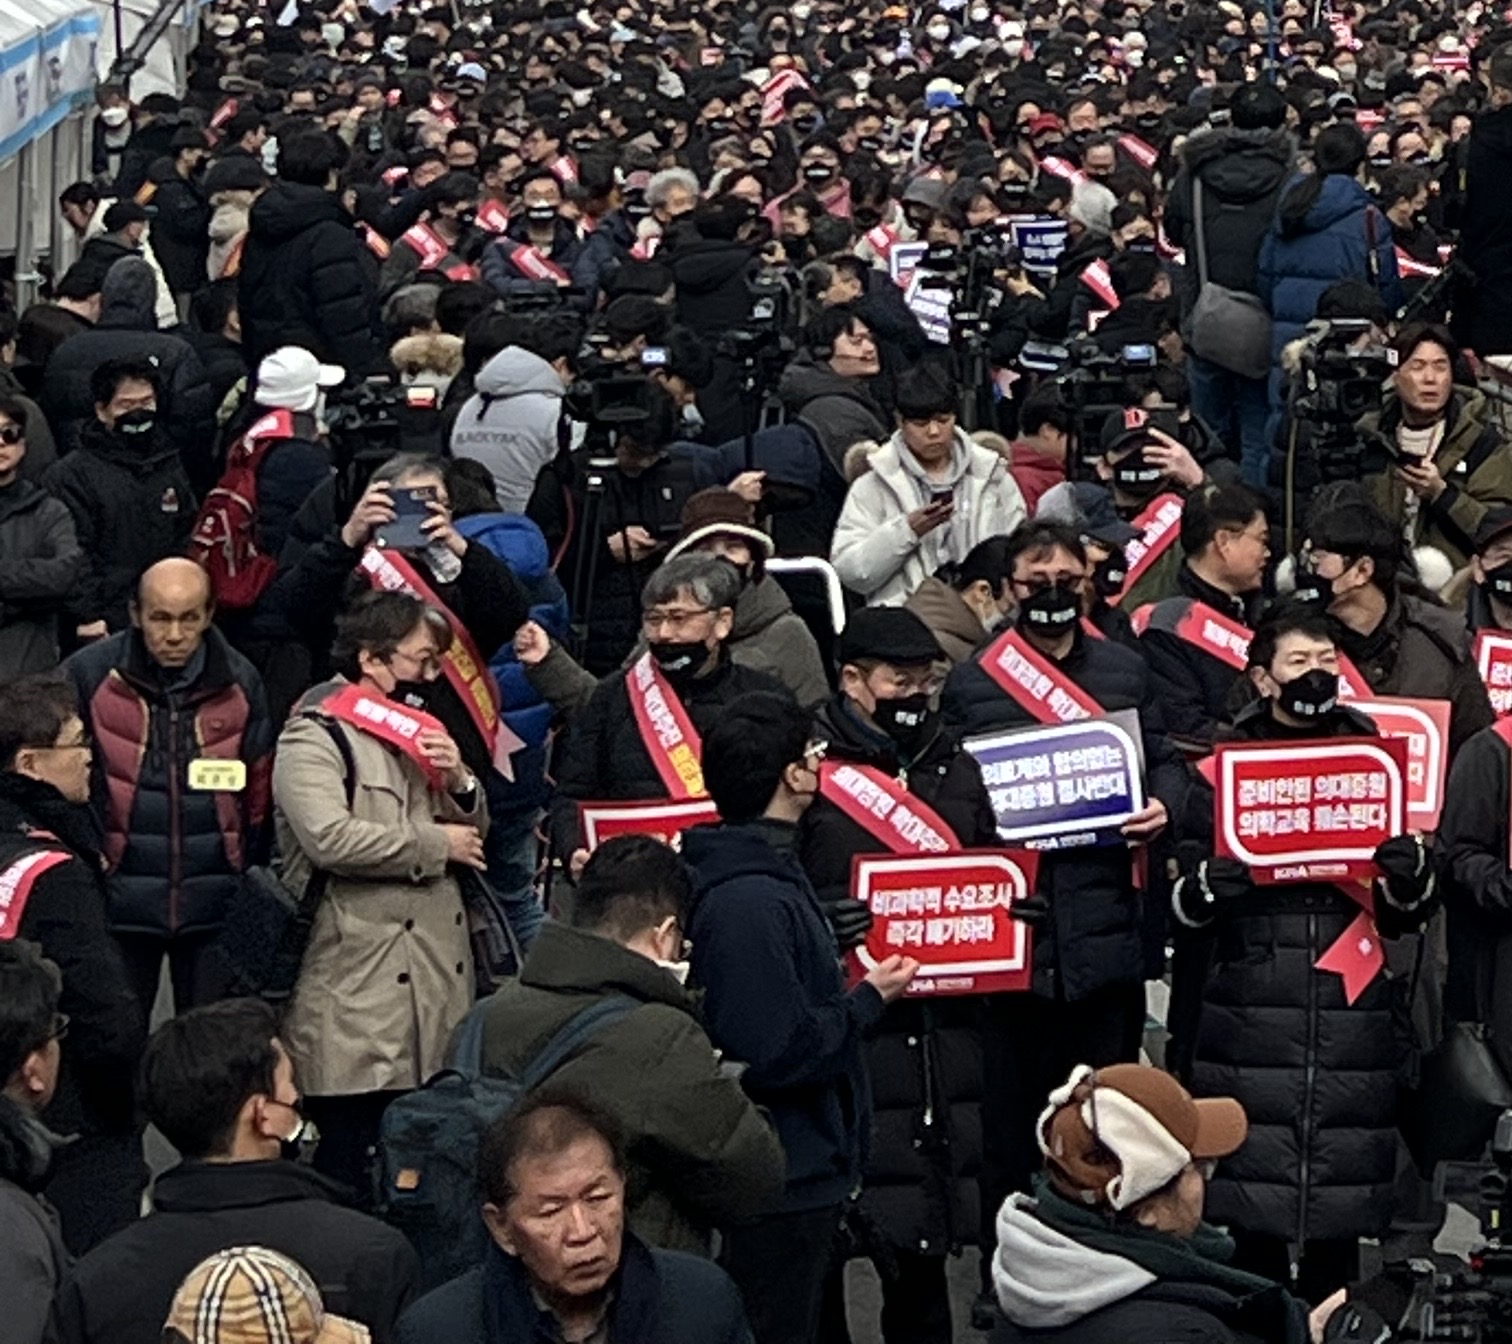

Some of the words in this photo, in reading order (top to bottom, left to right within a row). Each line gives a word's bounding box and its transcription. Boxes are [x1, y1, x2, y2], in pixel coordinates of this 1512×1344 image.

[1237, 776, 1311, 807] 준비안된
[1314, 771, 1387, 800] 의대증원
[1237, 806, 1310, 838] 의학교육
[943, 882, 1013, 913] 수요조사
